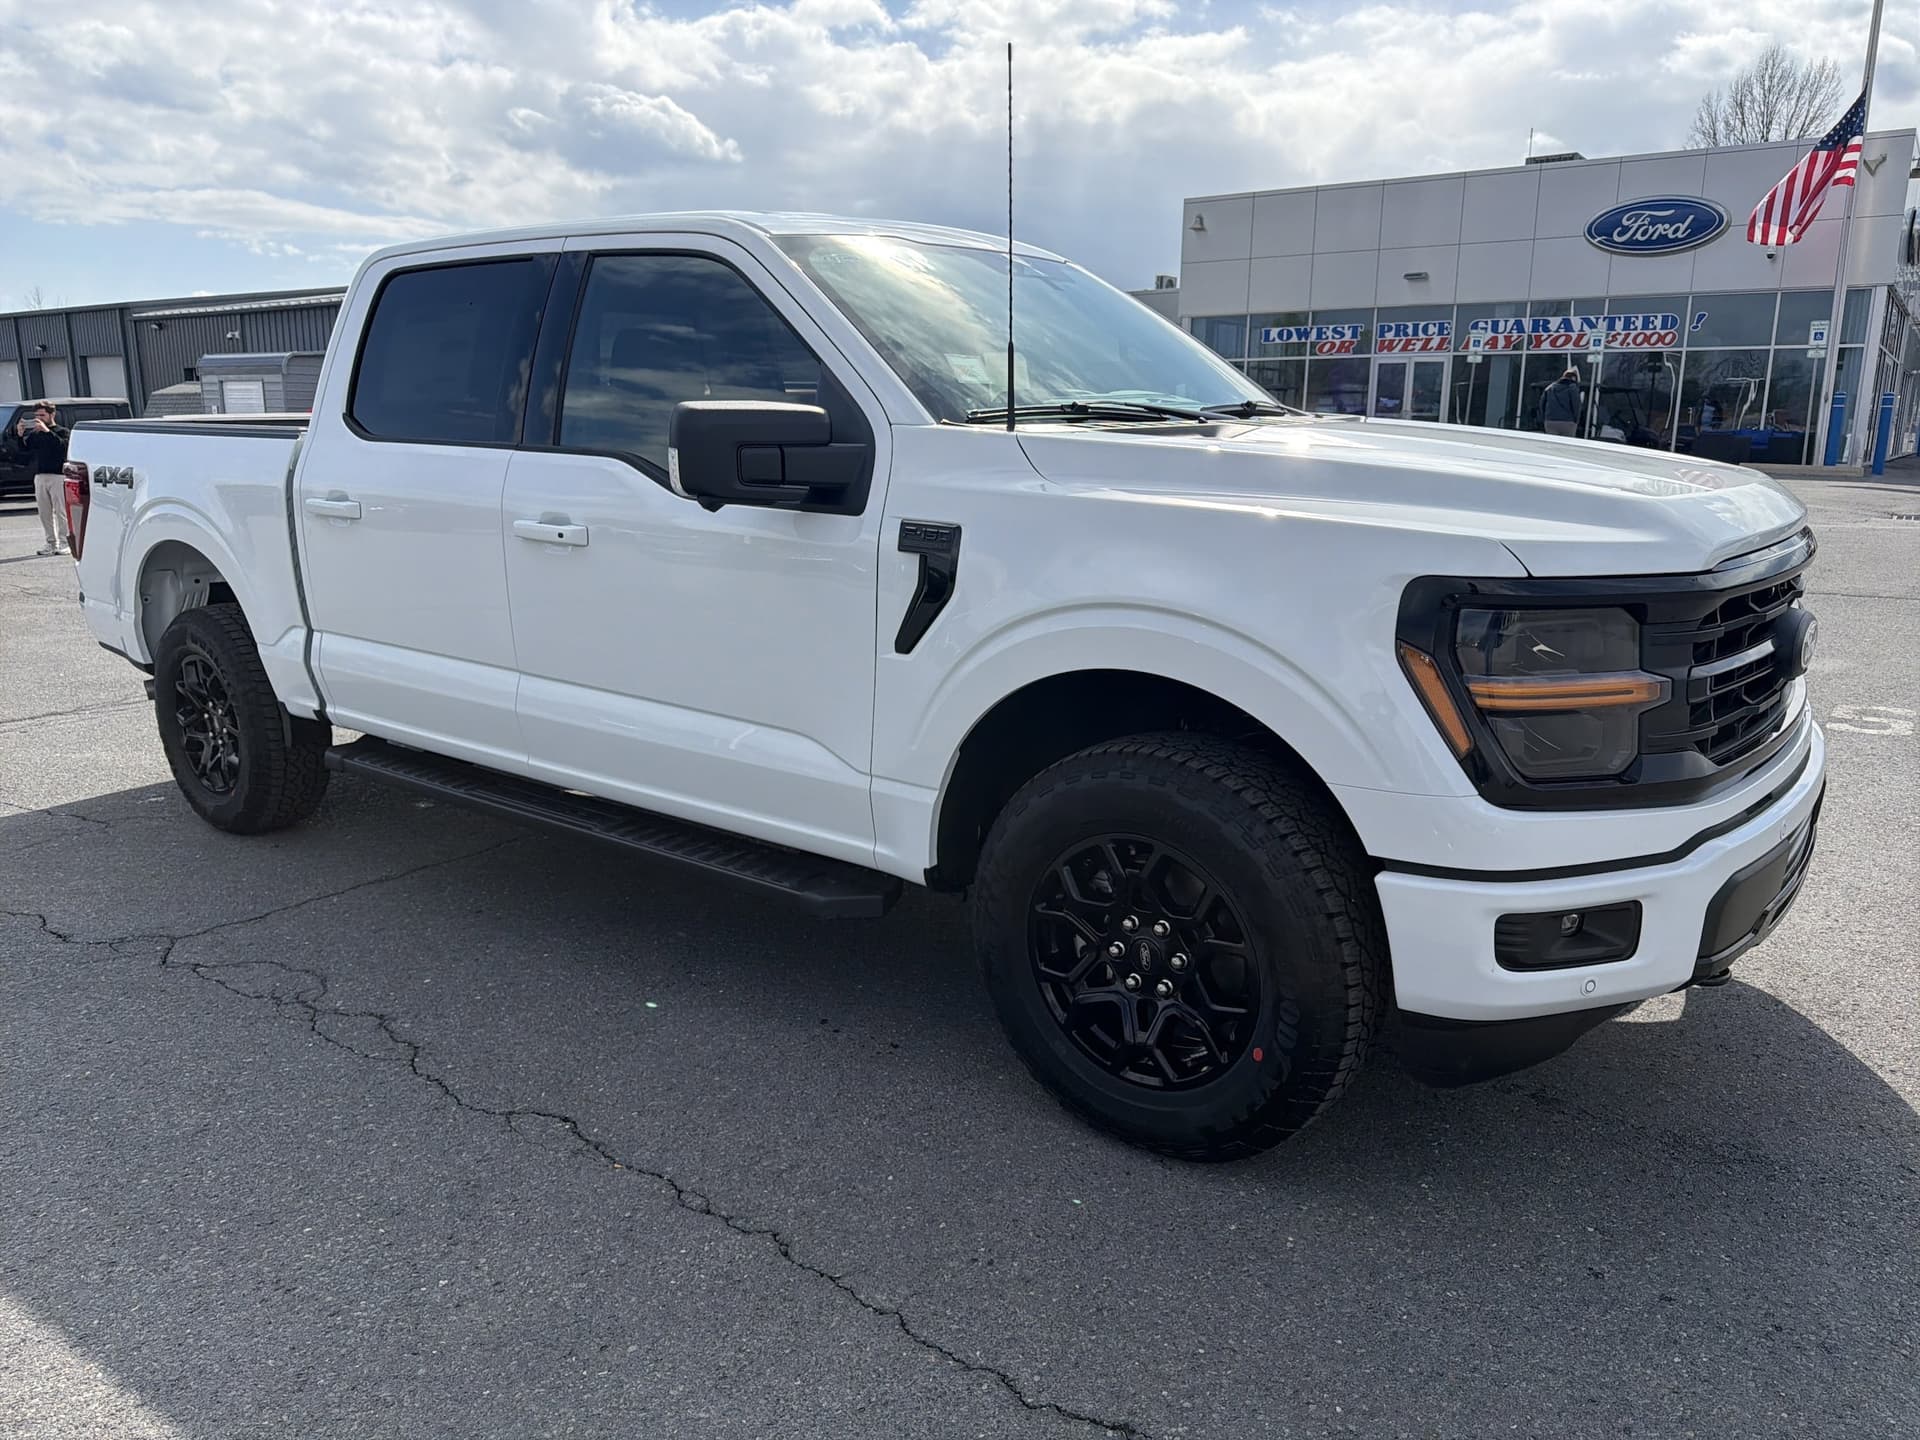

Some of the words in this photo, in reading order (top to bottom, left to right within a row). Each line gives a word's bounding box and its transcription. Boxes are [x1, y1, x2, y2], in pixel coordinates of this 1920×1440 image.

[1612, 209, 1695, 243] Ford
[1262, 324, 1364, 344] LOWEST
[1377, 321, 1451, 338] PRICE
[1469, 314, 1680, 334] GUARANTEED
[1315, 340, 1357, 355] OR
[1530, 333, 1592, 349] YOU
